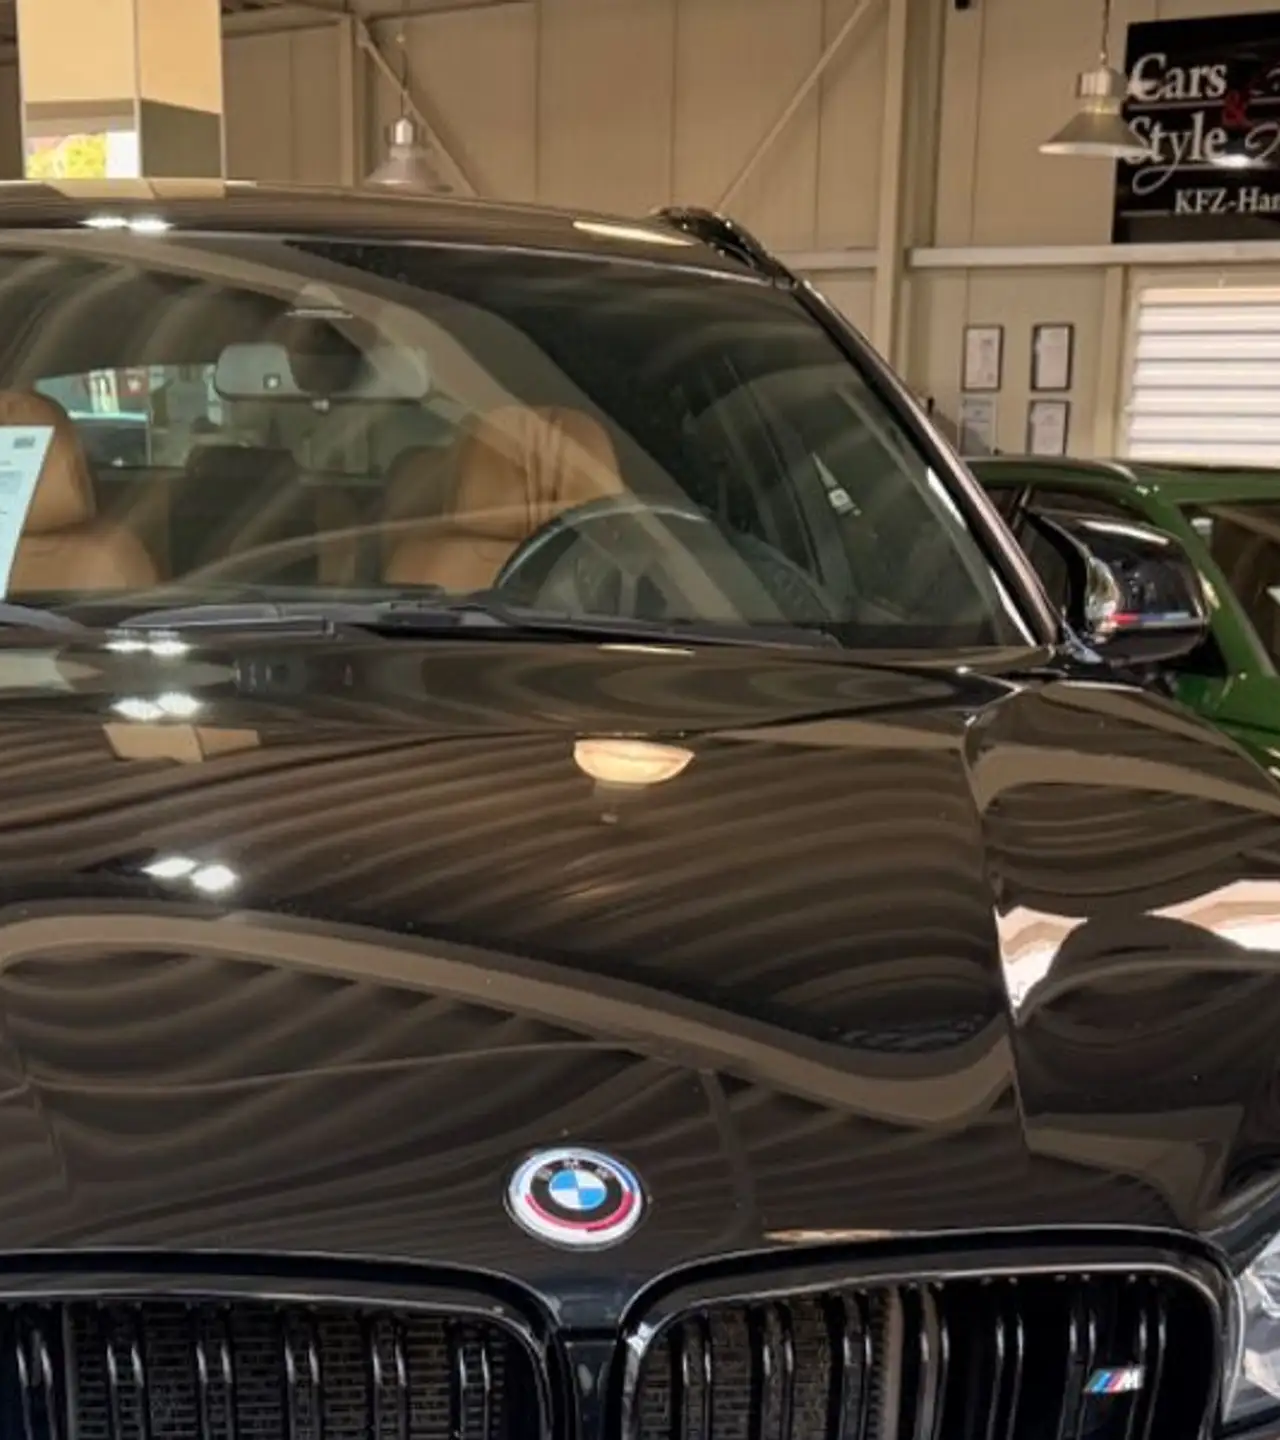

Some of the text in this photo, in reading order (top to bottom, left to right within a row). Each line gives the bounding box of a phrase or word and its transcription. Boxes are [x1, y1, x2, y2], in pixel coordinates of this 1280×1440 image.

[1127, 53, 1228, 101] Cars
[1221, 90, 1249, 125] &
[1123, 111, 1228, 195] Style
